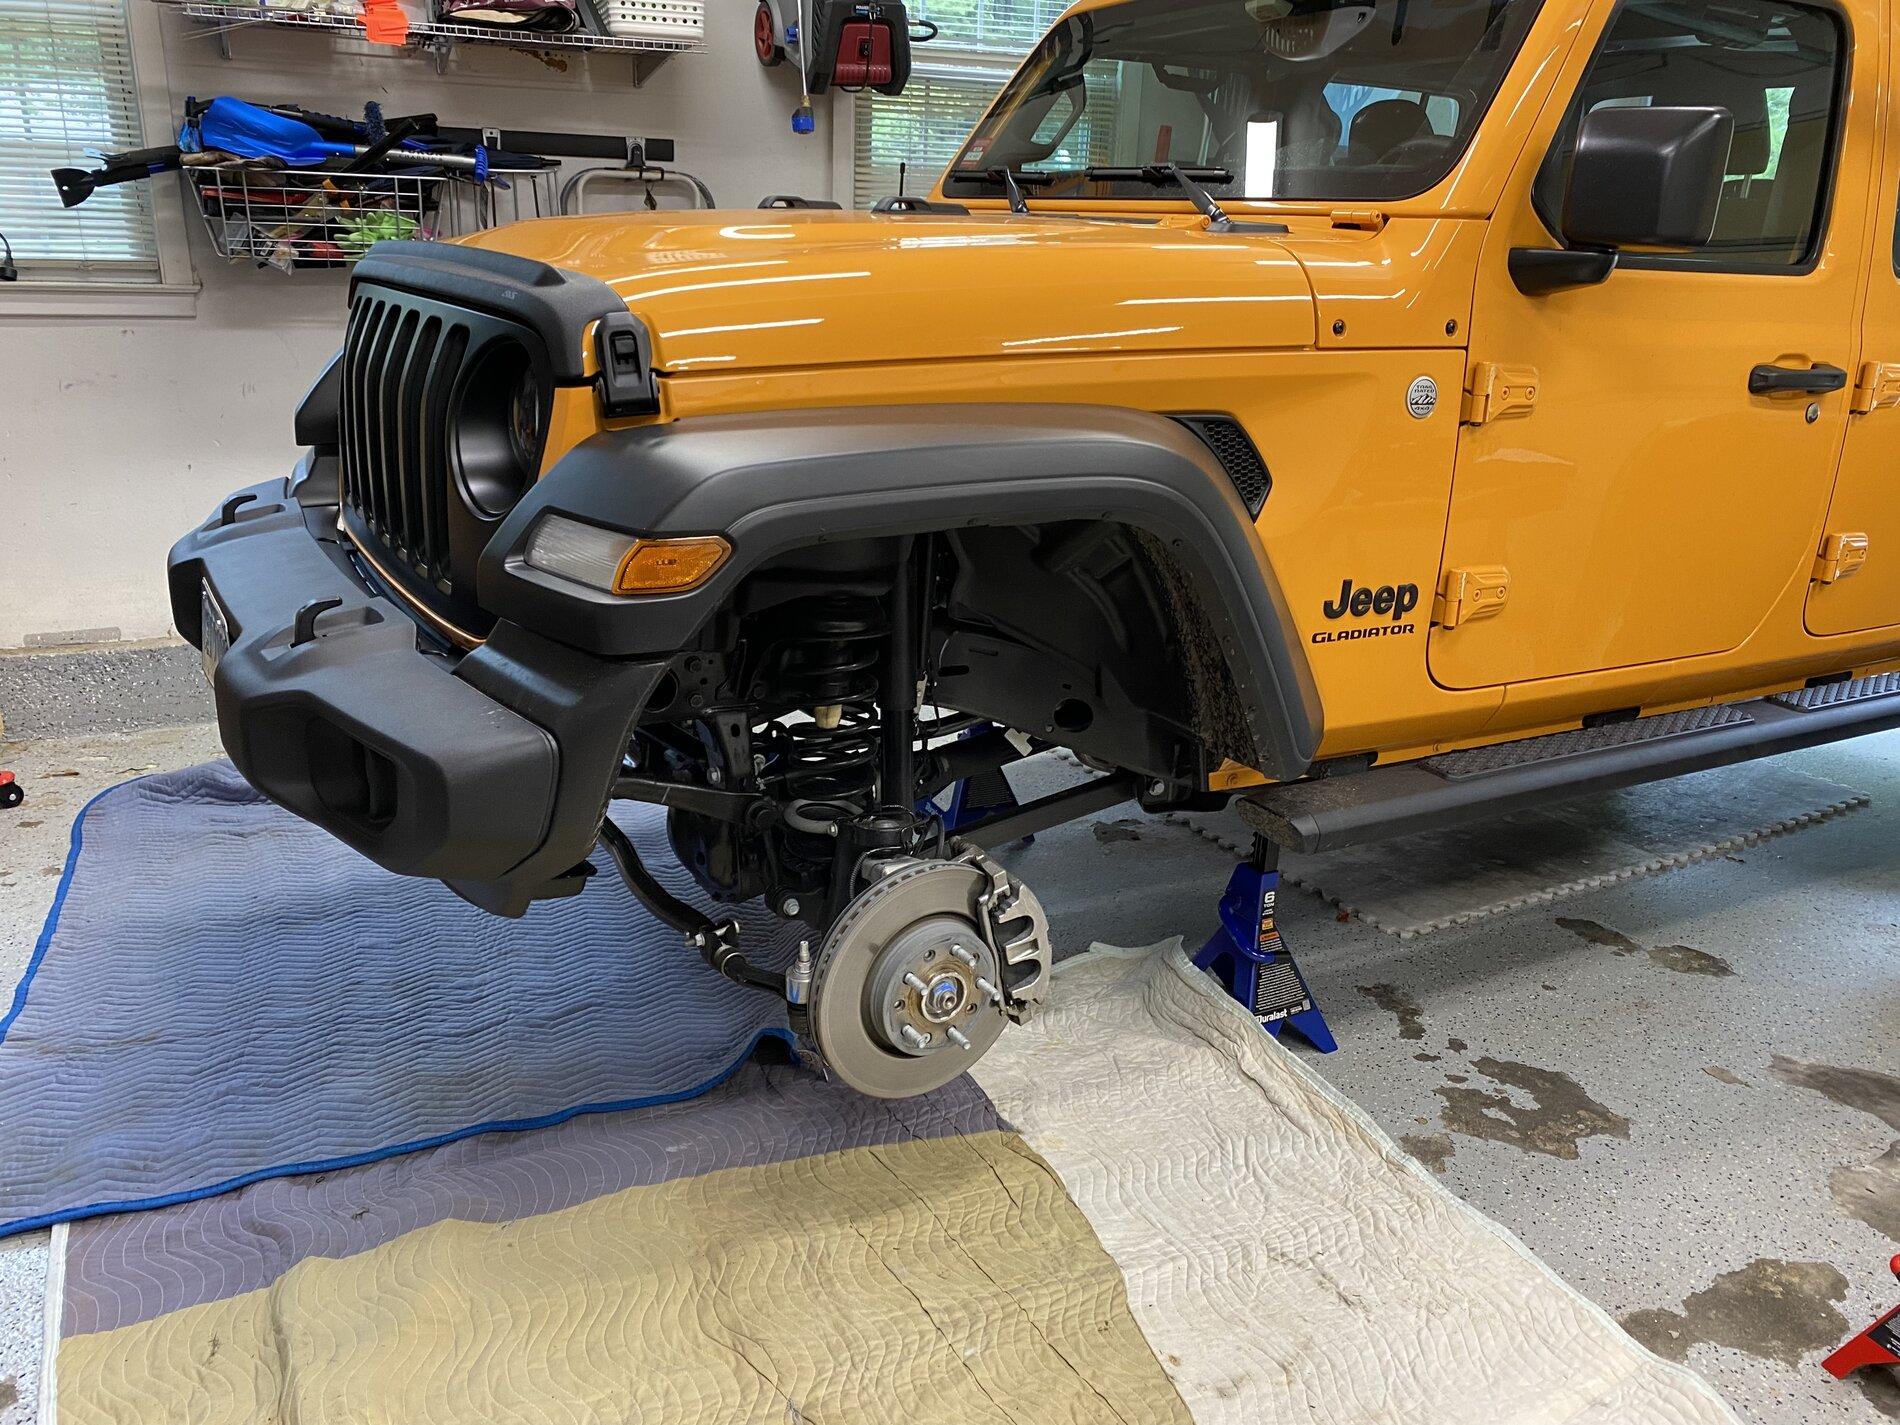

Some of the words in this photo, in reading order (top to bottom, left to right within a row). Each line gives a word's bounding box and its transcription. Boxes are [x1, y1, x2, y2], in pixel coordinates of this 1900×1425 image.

[1323, 578, 1419, 621] Jeep
[1311, 623, 1415, 644] GLADIATOR
[1264, 891, 1275, 903] 6
